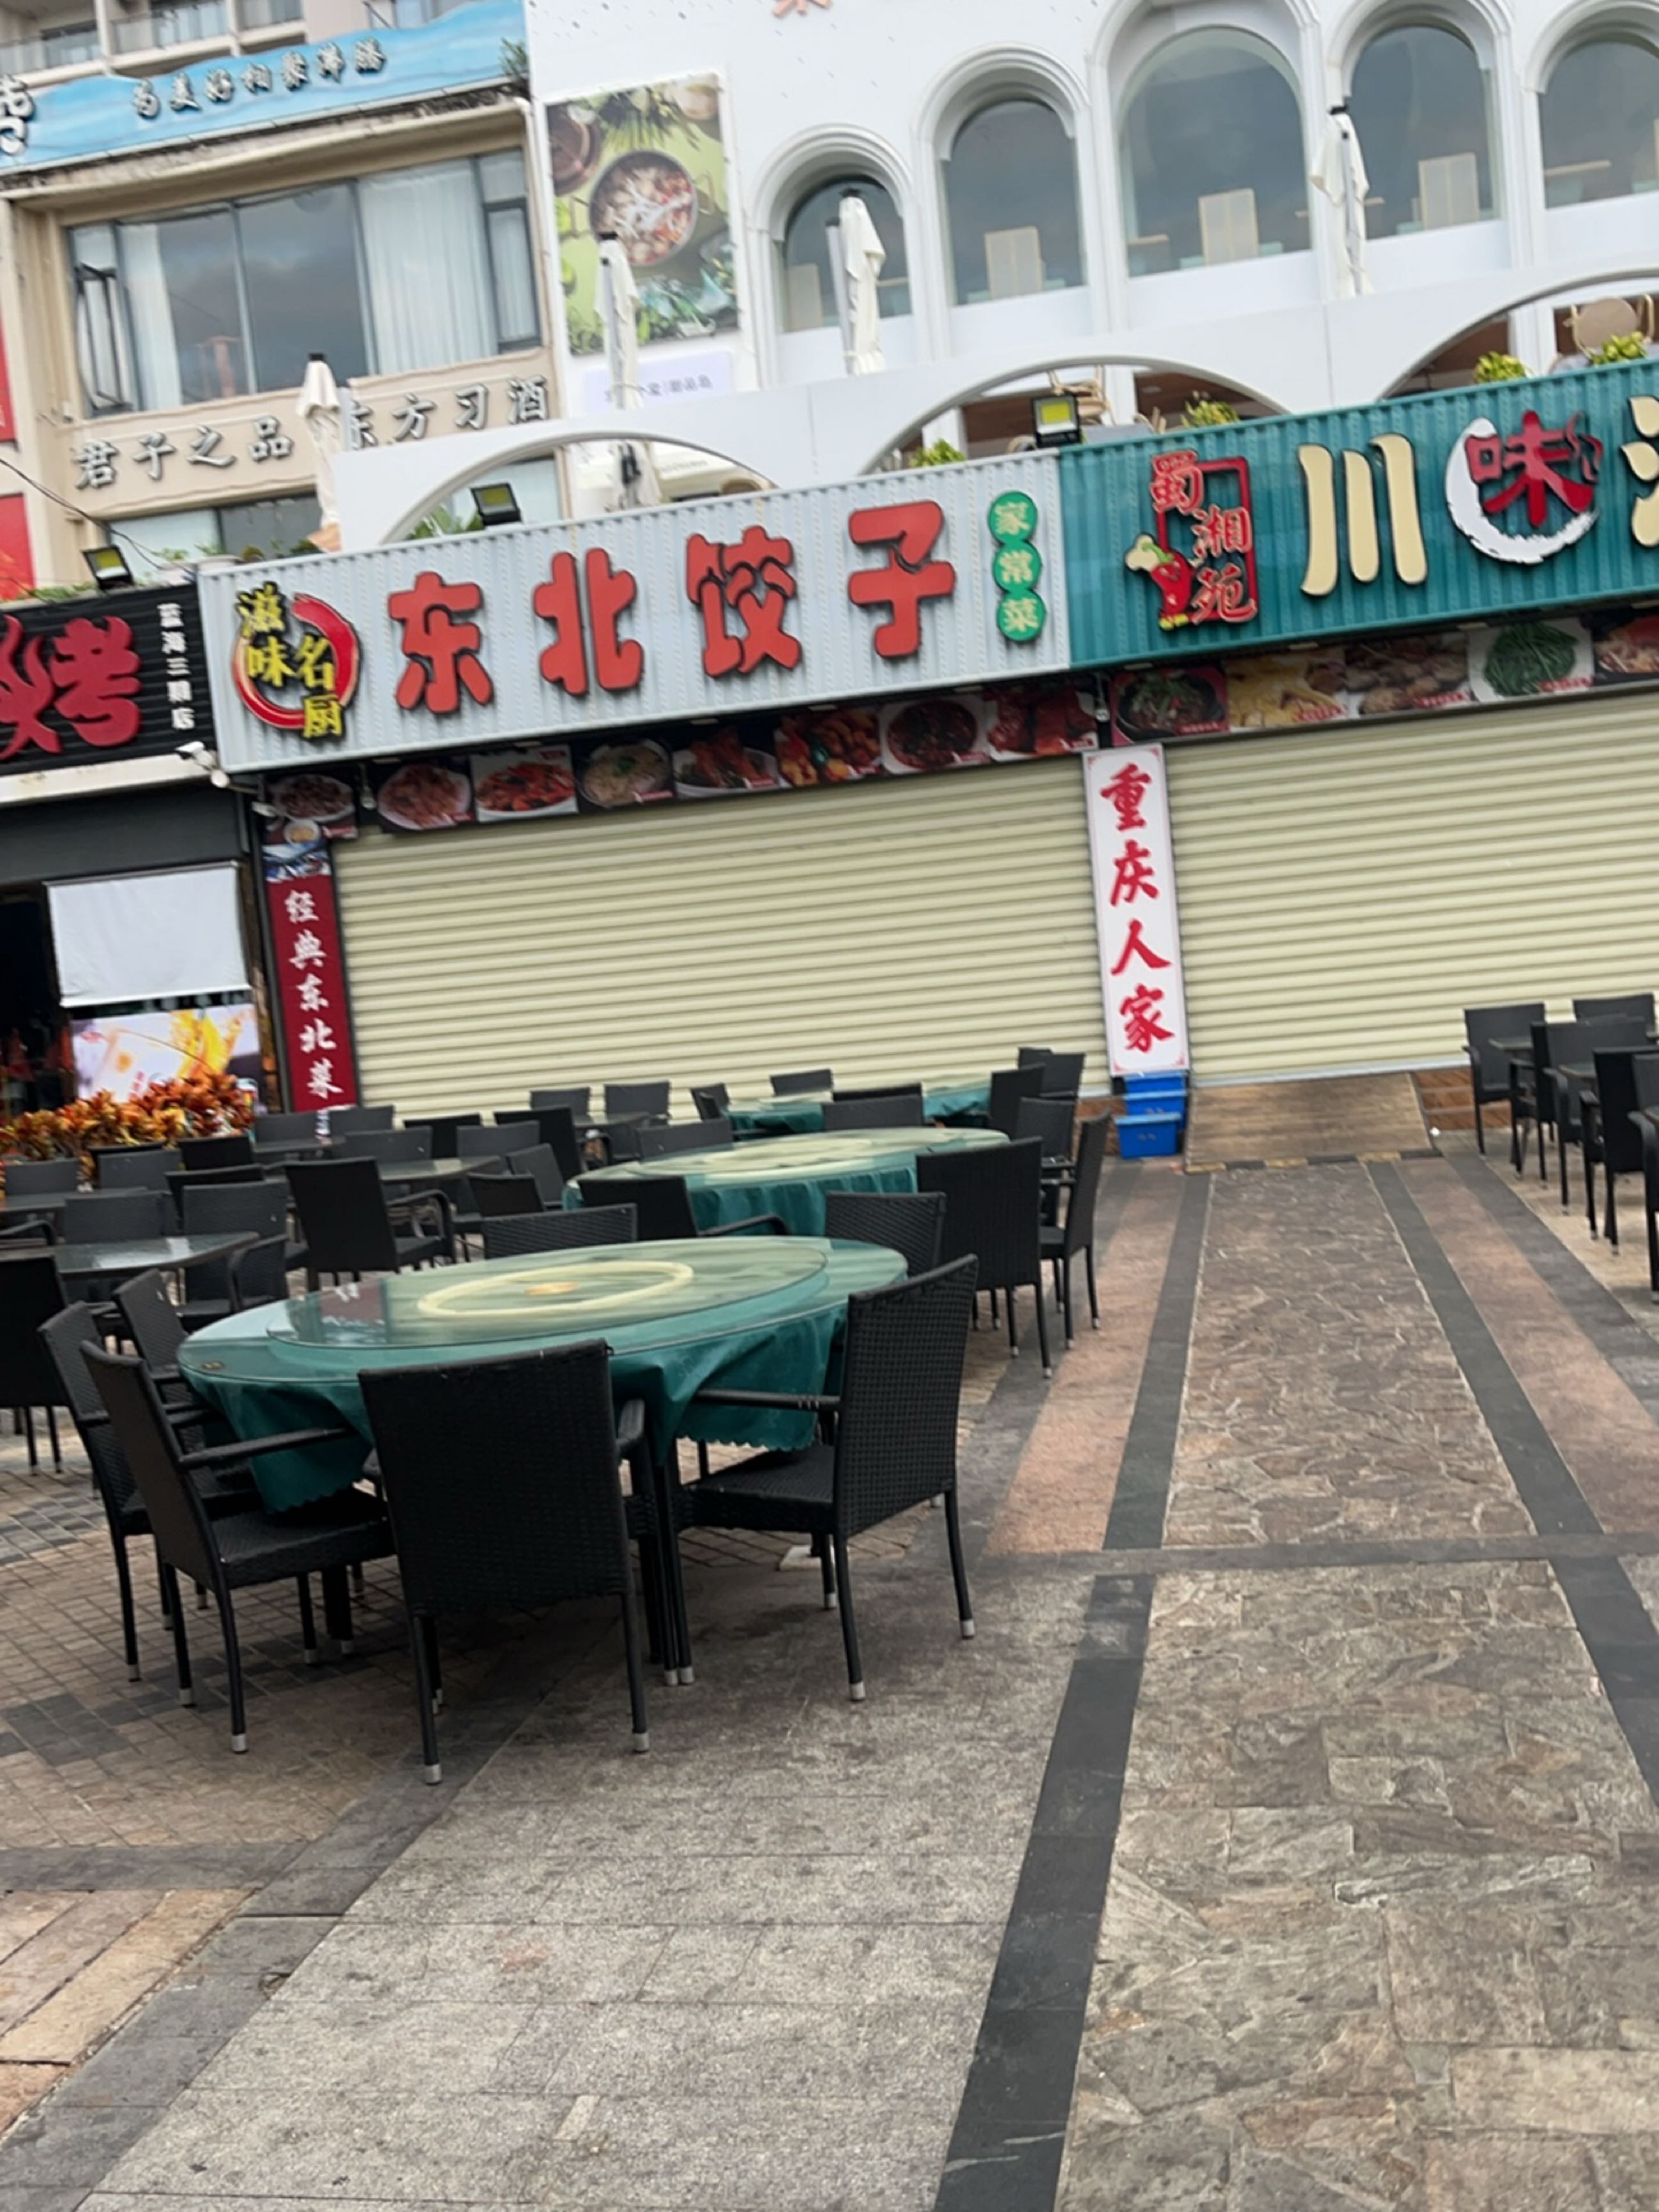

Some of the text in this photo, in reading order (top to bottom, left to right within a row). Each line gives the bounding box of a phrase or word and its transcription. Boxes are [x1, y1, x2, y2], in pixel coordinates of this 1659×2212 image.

[75, 415, 294, 490] 君子之品
[1150, 449, 1258, 625] 蜀湘苑
[1298, 395, 1659, 597] 川味
[388, 501, 956, 714] 东北饺子
[995, 502, 1039, 632] 家常菜
[284, 890, 344, 1099] 经典东北菜
[1100, 764, 1176, 1054] 重庆人家
